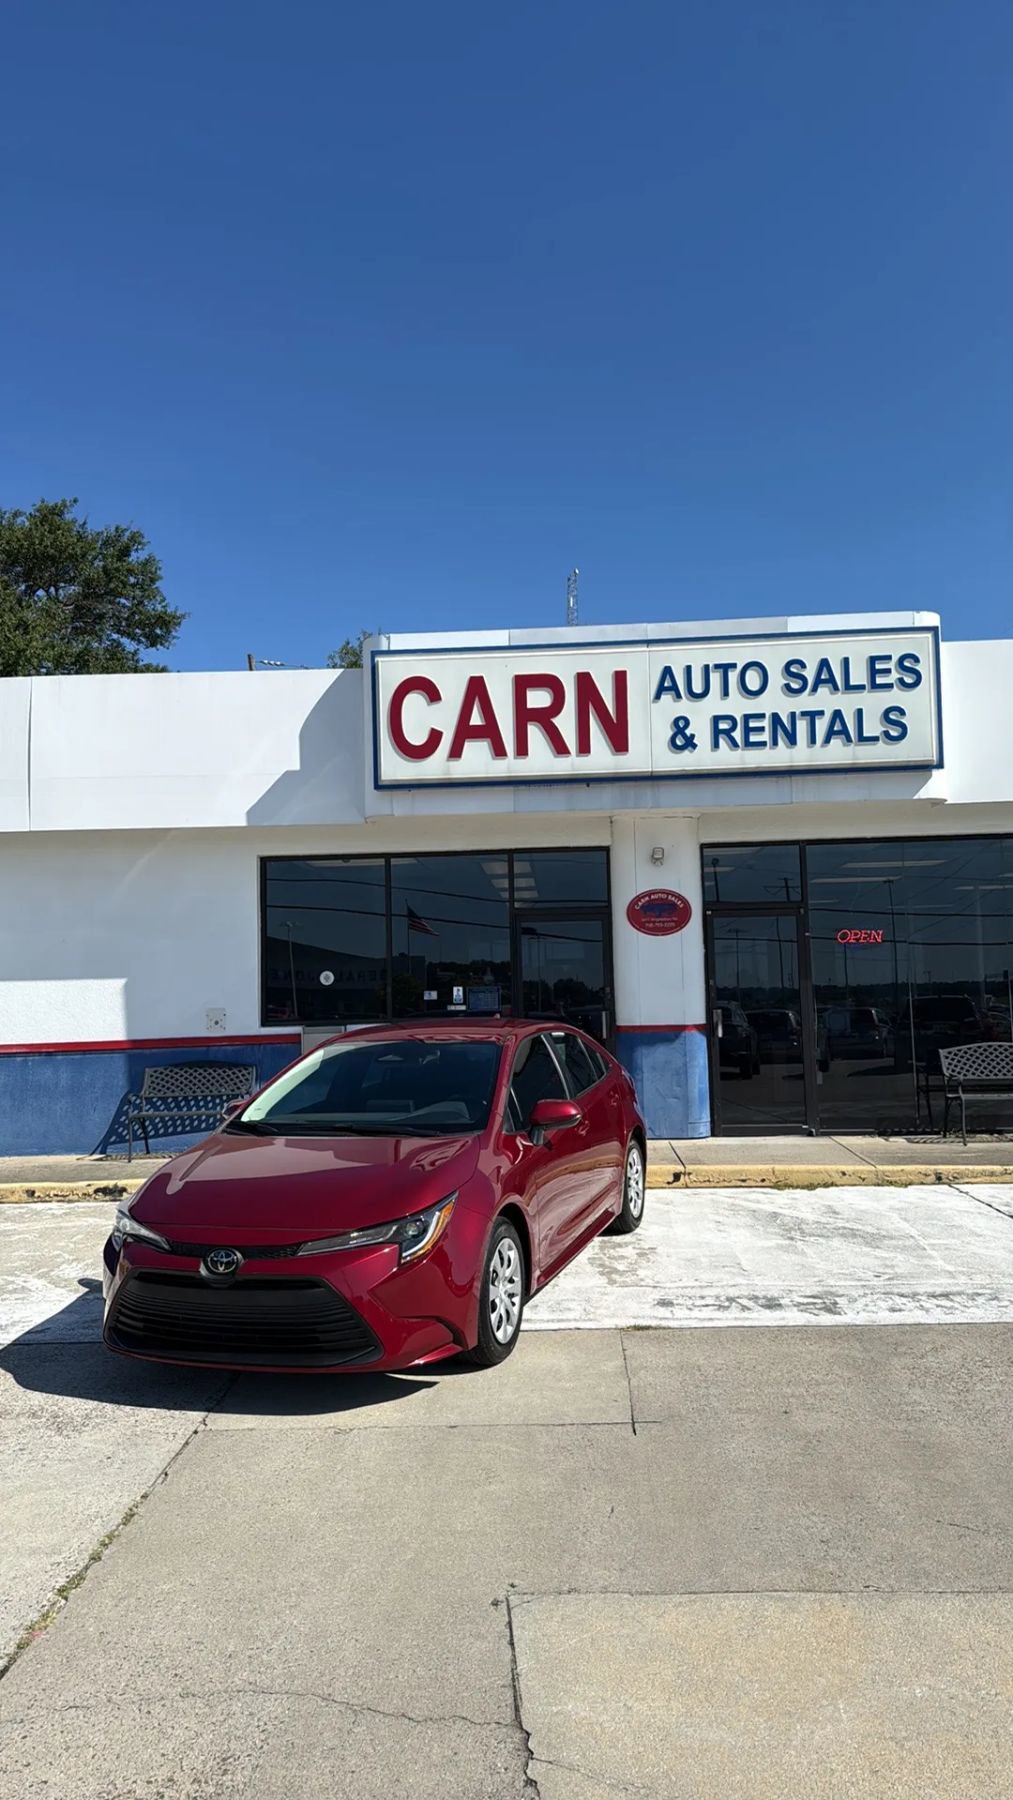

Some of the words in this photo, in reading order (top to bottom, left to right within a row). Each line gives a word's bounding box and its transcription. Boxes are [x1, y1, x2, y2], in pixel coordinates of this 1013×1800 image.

[654, 660, 769, 701] AUTO
[782, 652, 923, 695] SALES
[389, 670, 629, 760] CARN
[669, 714, 698, 751] &
[711, 705, 908, 750] RENTALS
[634, 896, 649, 910] CARN
[668, 894, 685, 908] SALES
[836, 929, 884, 944] OPEN
